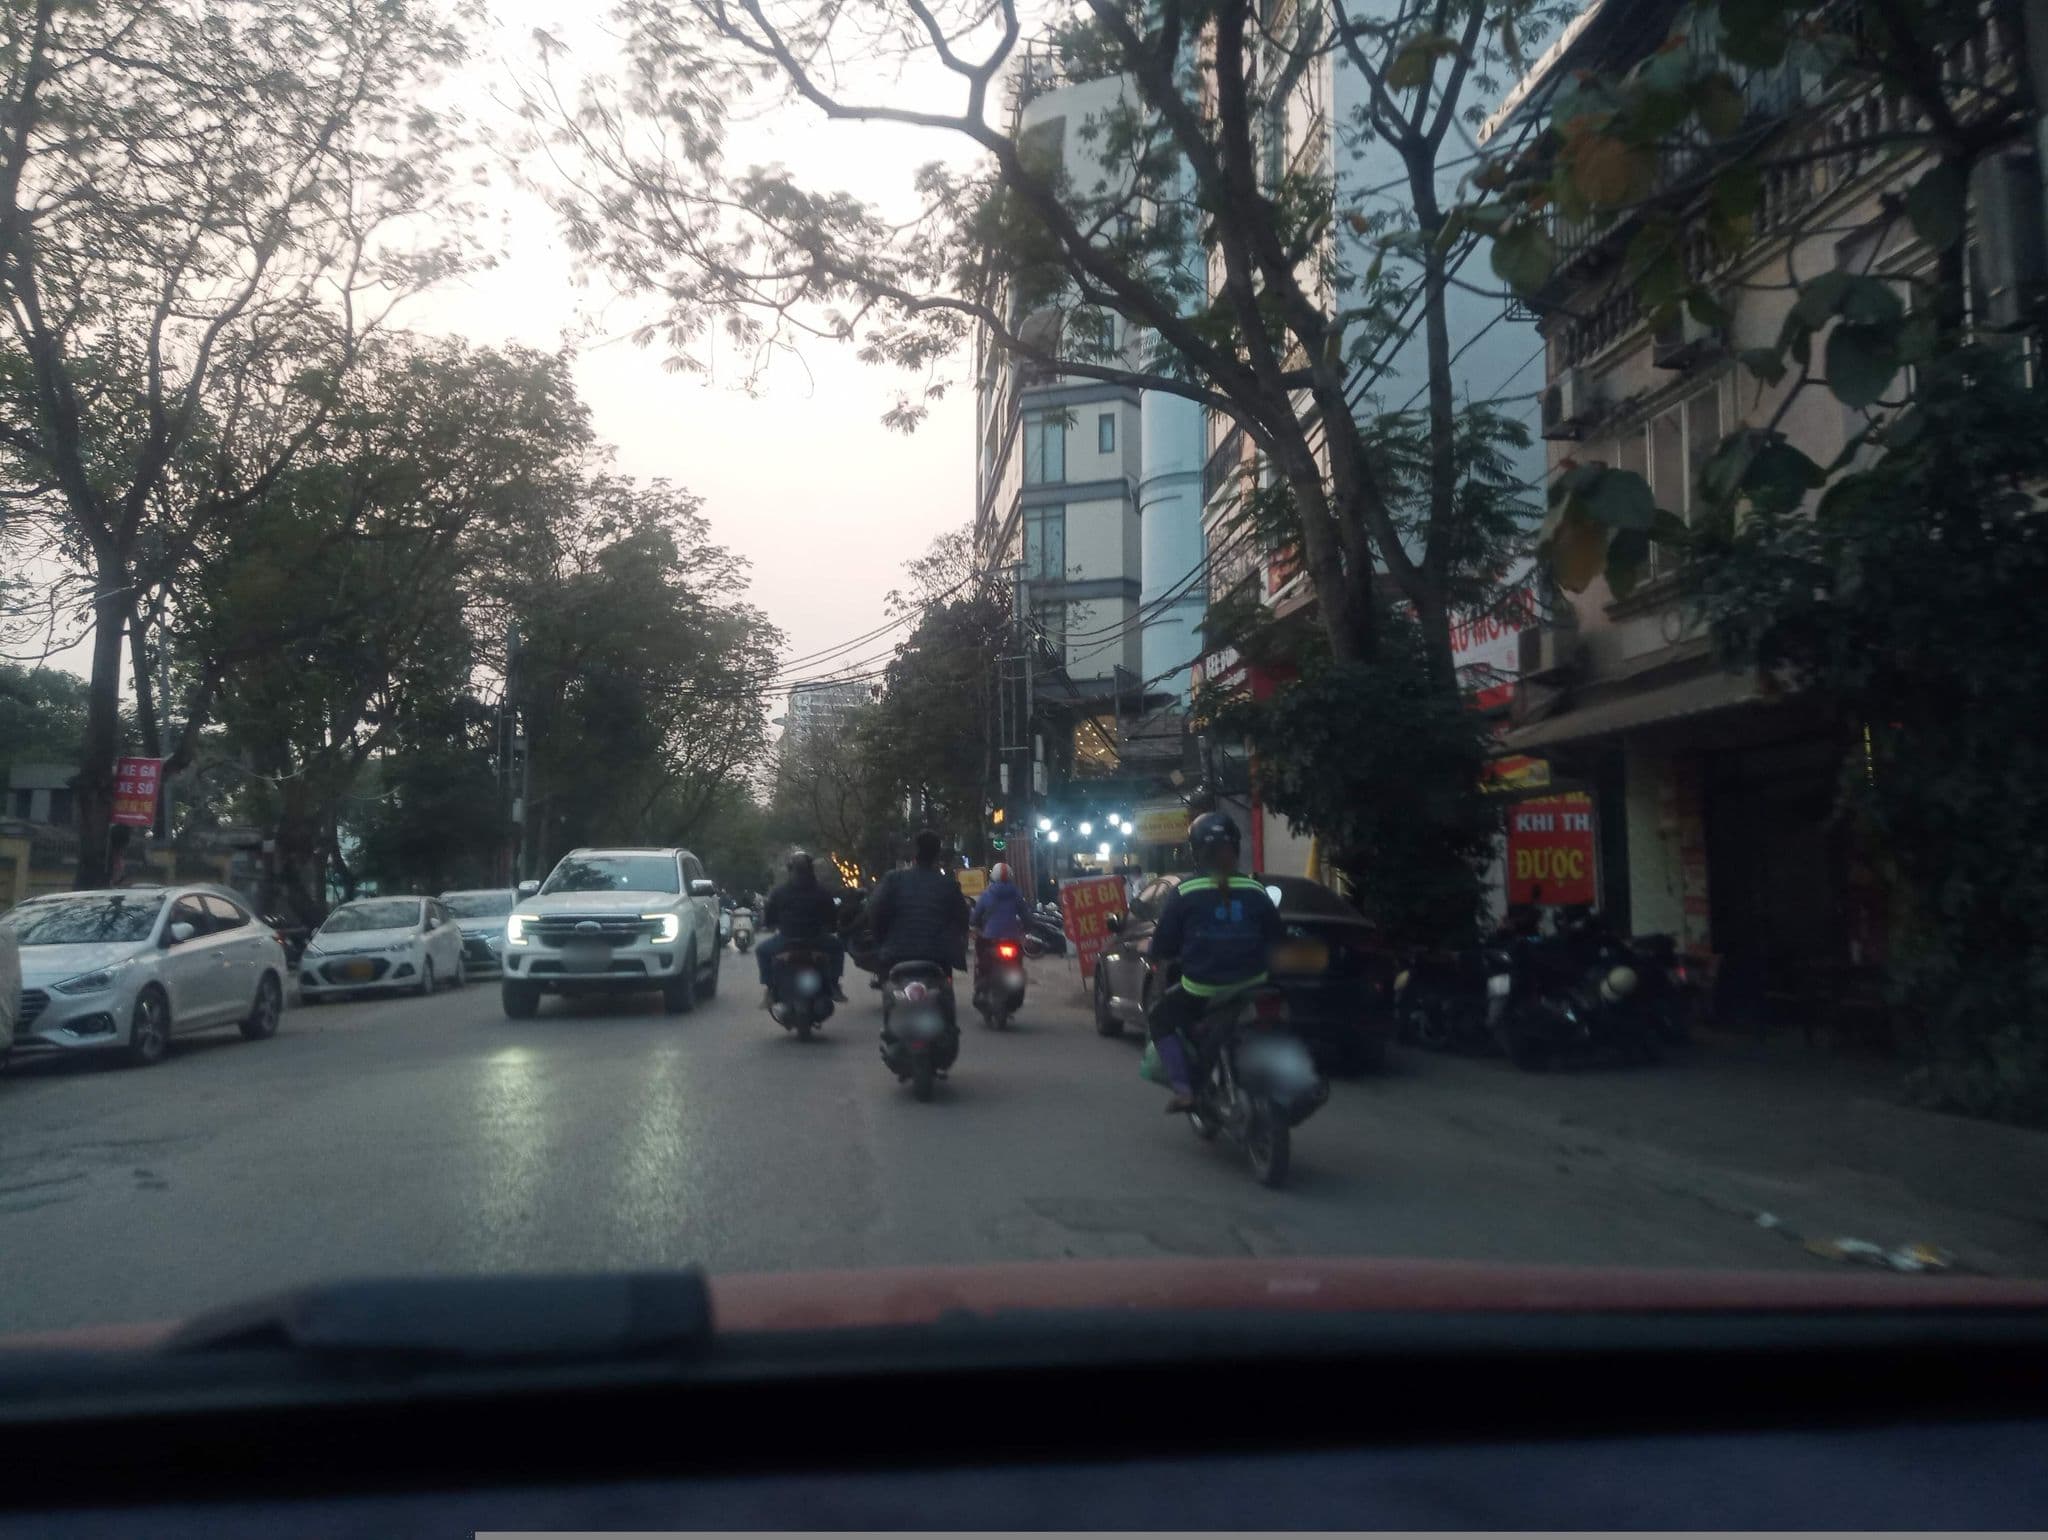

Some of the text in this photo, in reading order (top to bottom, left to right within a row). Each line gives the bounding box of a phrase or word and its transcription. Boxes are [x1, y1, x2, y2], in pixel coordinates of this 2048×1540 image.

[140, 765, 157, 777] GA
[117, 781, 134, 794] XE
[1515, 813, 1554, 832] KHI
[1515, 846, 1585, 888] ĐƯỢC
[1071, 881, 1122, 909] XE GA
[1078, 912, 1099, 937] XE
